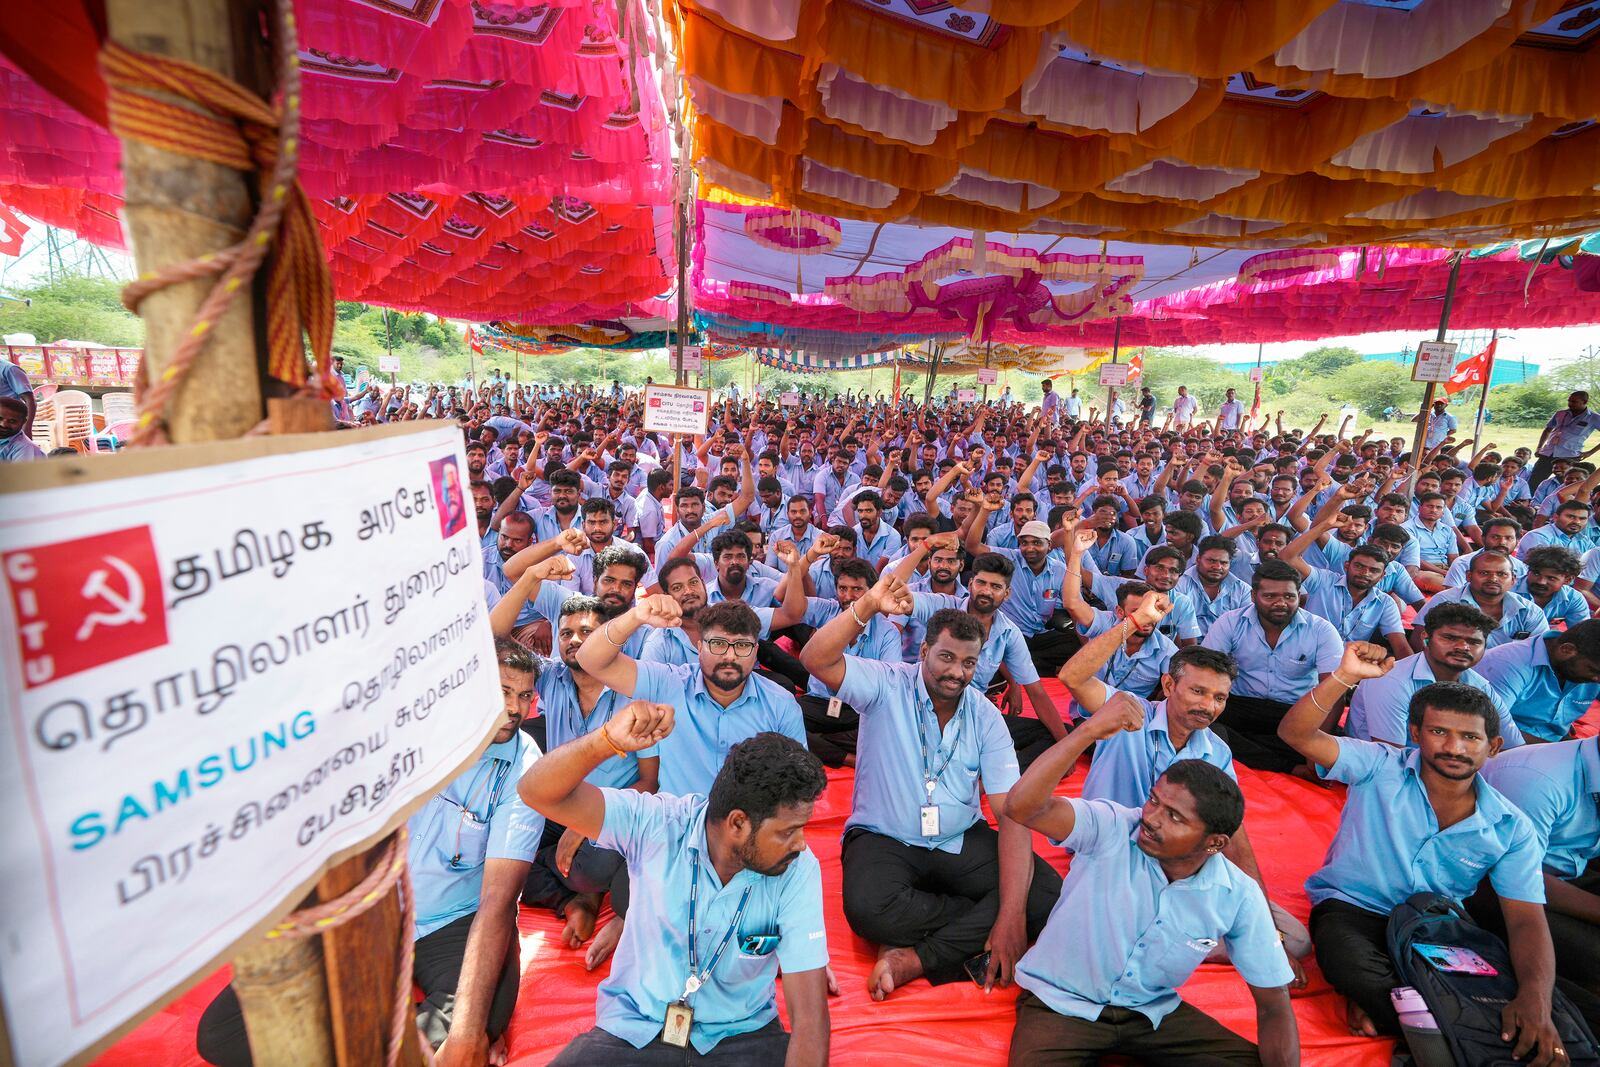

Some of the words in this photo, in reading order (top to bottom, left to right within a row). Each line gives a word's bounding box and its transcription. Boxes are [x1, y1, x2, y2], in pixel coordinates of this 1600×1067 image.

[169, 518, 333, 609] தமிழக
[356, 482, 435, 542] அரசே!
[7, 553, 55, 684] CITU
[33, 593, 373, 756] தொழிலாளர்
[68, 710, 318, 852] SAMSUNG
[297, 745, 426, 848] பேசித்தீர்!
